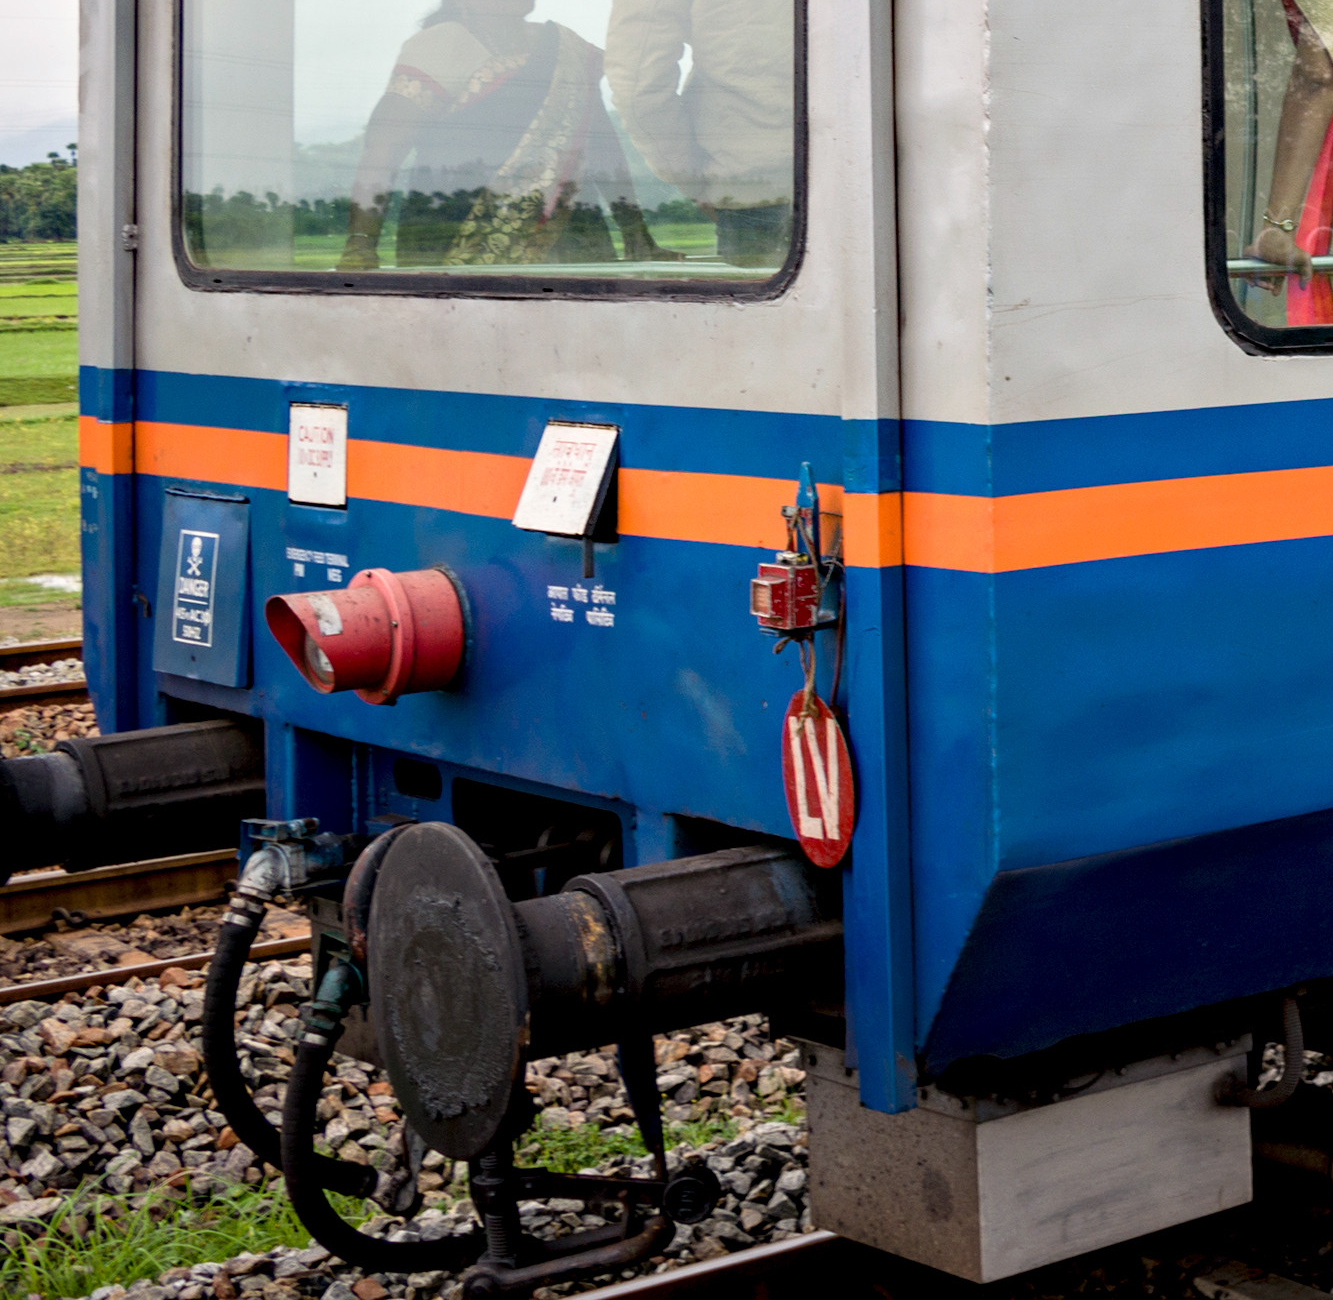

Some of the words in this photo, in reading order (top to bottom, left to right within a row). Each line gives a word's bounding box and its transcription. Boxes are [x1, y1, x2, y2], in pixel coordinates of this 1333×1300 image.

[298, 424, 334, 445] CAUTION
[178, 576, 210, 598] DANGER
[788, 716, 840, 841] LV
